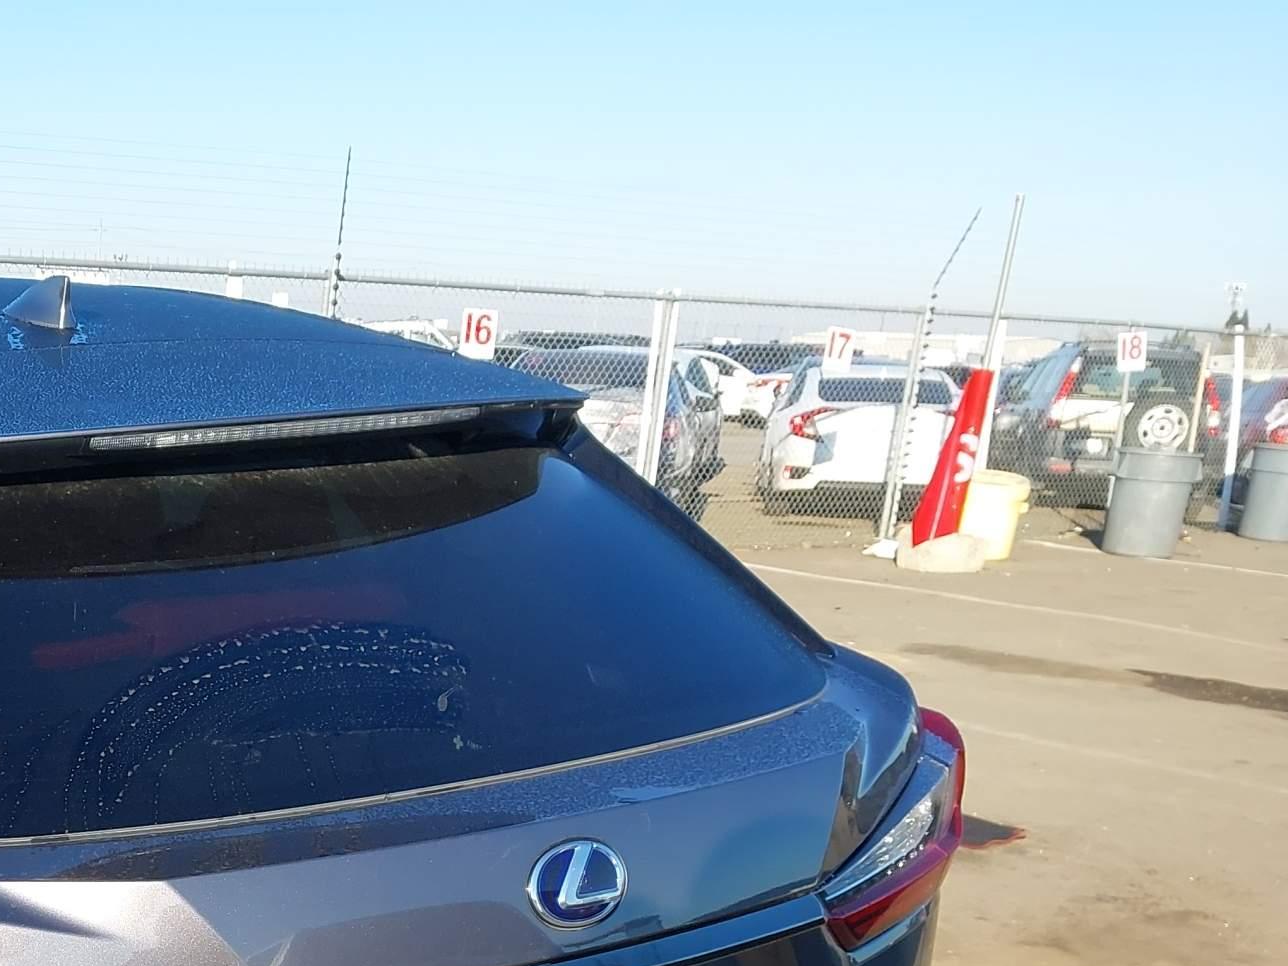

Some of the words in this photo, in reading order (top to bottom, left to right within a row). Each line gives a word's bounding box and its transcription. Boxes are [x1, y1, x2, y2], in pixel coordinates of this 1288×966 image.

[464, 312, 492, 345] 16
[828, 330, 852, 360] 17
[1121, 335, 1142, 361] 18
